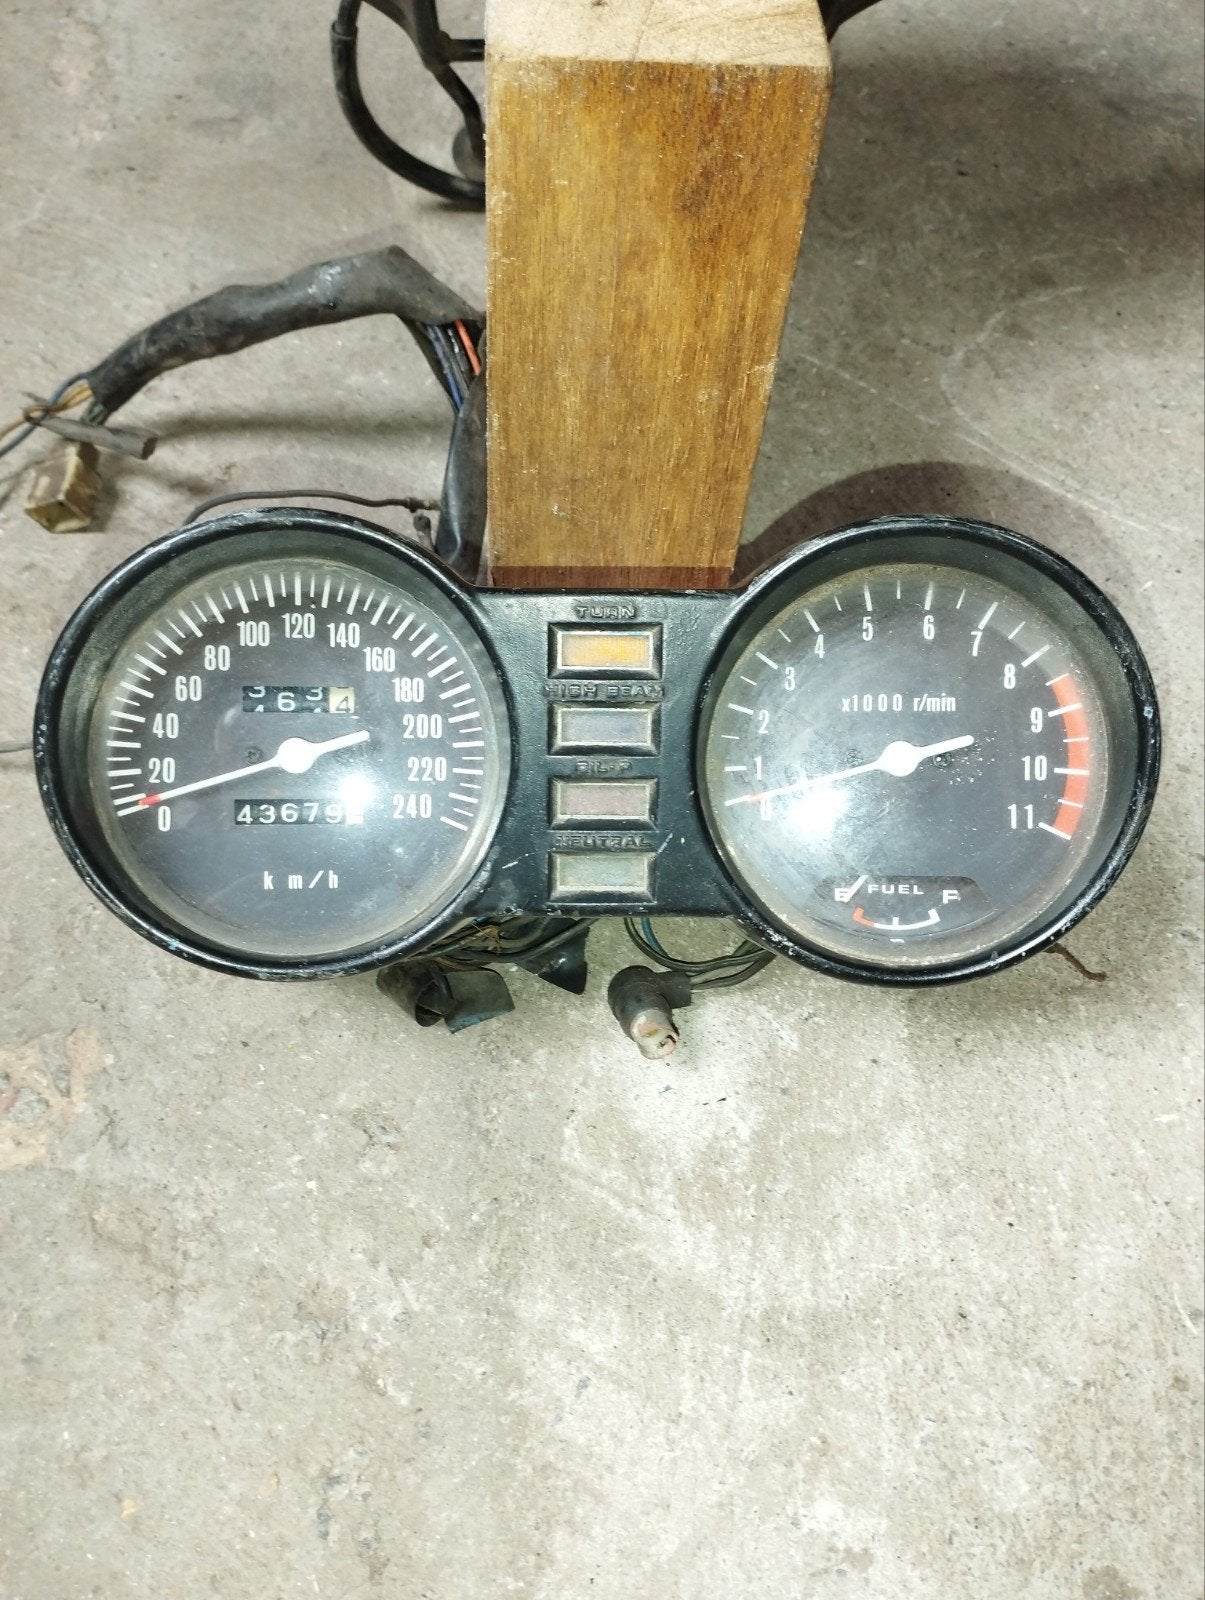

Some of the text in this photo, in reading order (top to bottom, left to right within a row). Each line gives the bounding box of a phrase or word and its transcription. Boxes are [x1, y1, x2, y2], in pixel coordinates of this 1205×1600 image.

[577, 605, 636, 619] TURN
[237, 621, 270, 647] 100
[281, 613, 315, 639] 120
[327, 623, 360, 648] 140
[862, 617, 873, 641] 5
[922, 614, 935, 640] 6
[814, 634, 826, 659] 4
[971, 631, 983, 656] 7
[204, 645, 231, 671] 80
[363, 647, 396, 673] 160
[175, 675, 203, 702] 60
[785, 667, 797, 692] 3
[1003, 663, 1016, 690] 8
[392, 677, 425, 703] 180
[544, 684, 665, 699] HIGH BEAM
[913, 692, 957, 712] r/min
[152, 712, 179, 739] 40
[402, 713, 443, 739] 200
[757, 710, 770, 734] 2
[1030, 707, 1043, 733] 9
[148, 757, 176, 783] 20
[407, 756, 447, 782] 220
[754, 756, 763, 780] 1
[1022, 755, 1047, 781] 10
[157, 805, 171, 831] 0
[236, 802, 364, 825] 43679
[392, 793, 432, 819] 240
[1007, 803, 1033, 829] 11
[555, 835, 652, 849] NEUTRAL
[834, 884, 959, 904] E FUEL F
